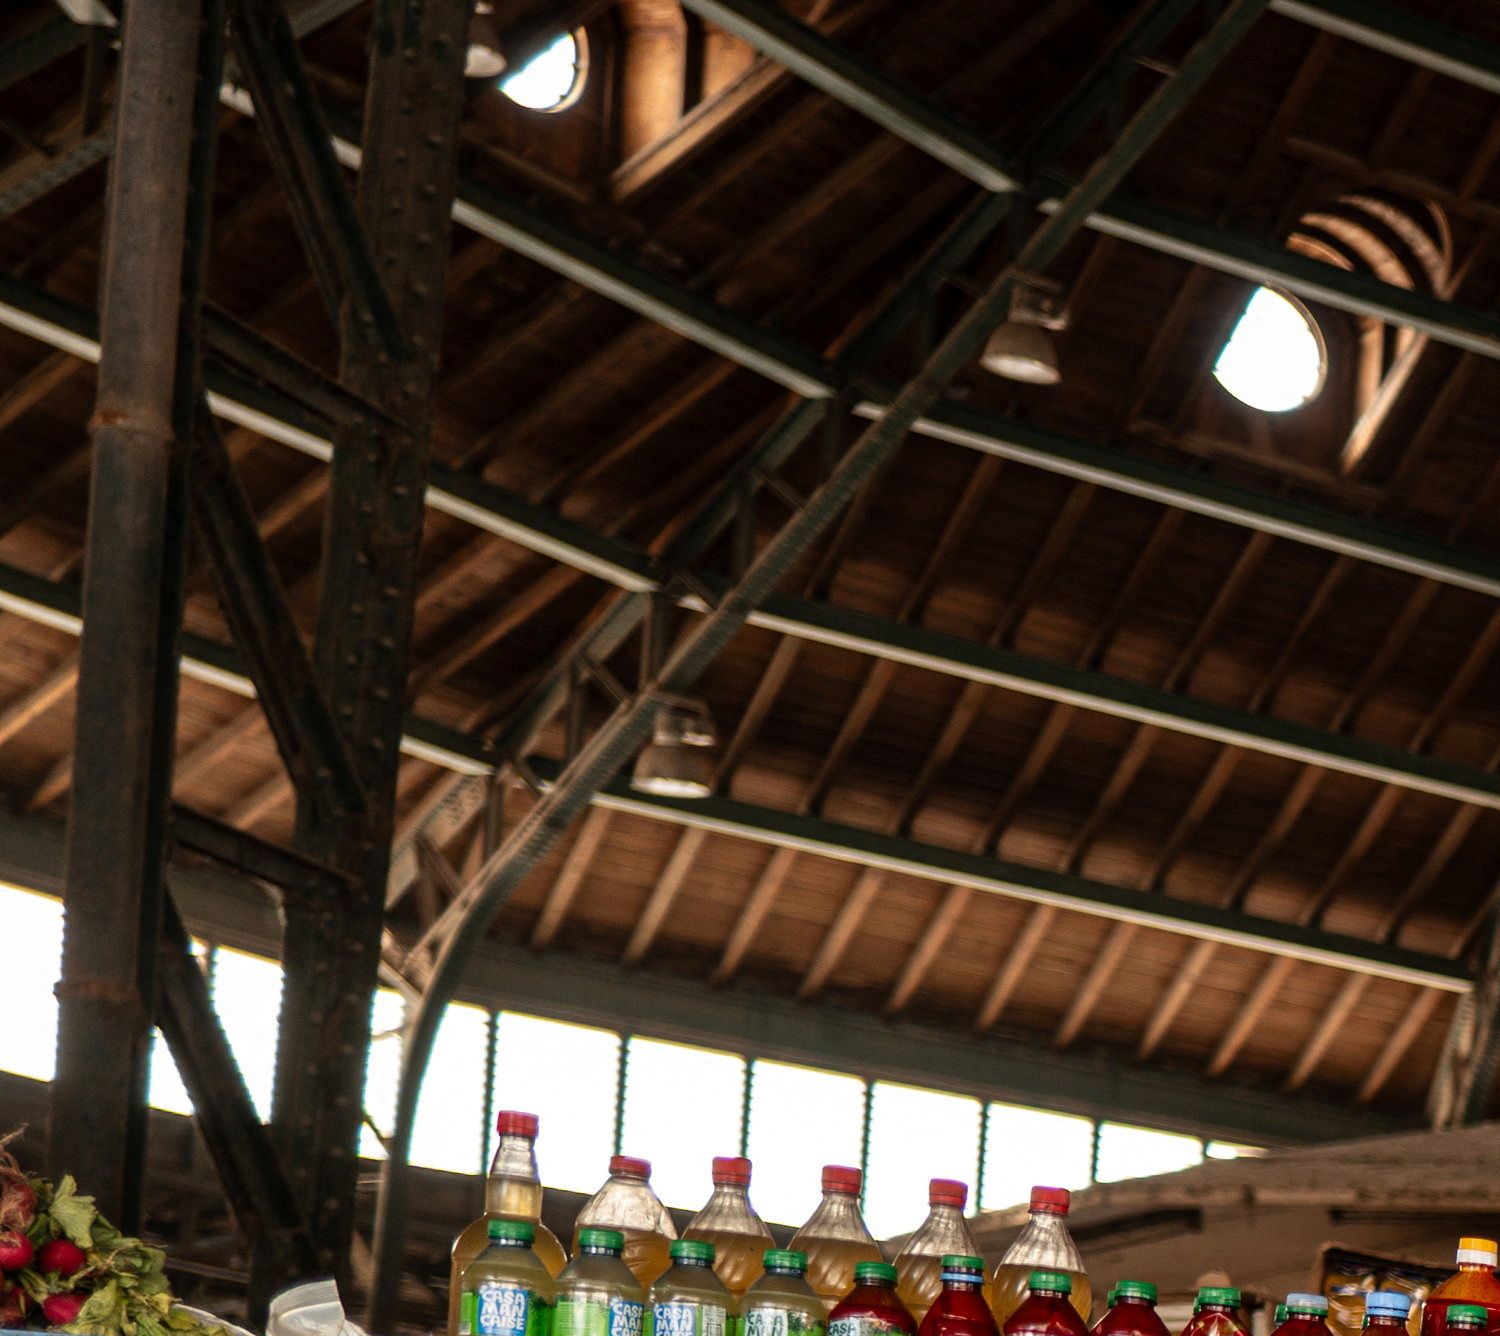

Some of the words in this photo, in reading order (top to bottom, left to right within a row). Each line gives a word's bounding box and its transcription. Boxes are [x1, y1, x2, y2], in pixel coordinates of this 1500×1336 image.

[481, 1290, 525, 1304] CASA
[481, 1302, 525, 1317] MAN
[655, 1306, 692, 1321] CASA
[656, 1319, 692, 1332] MAN
